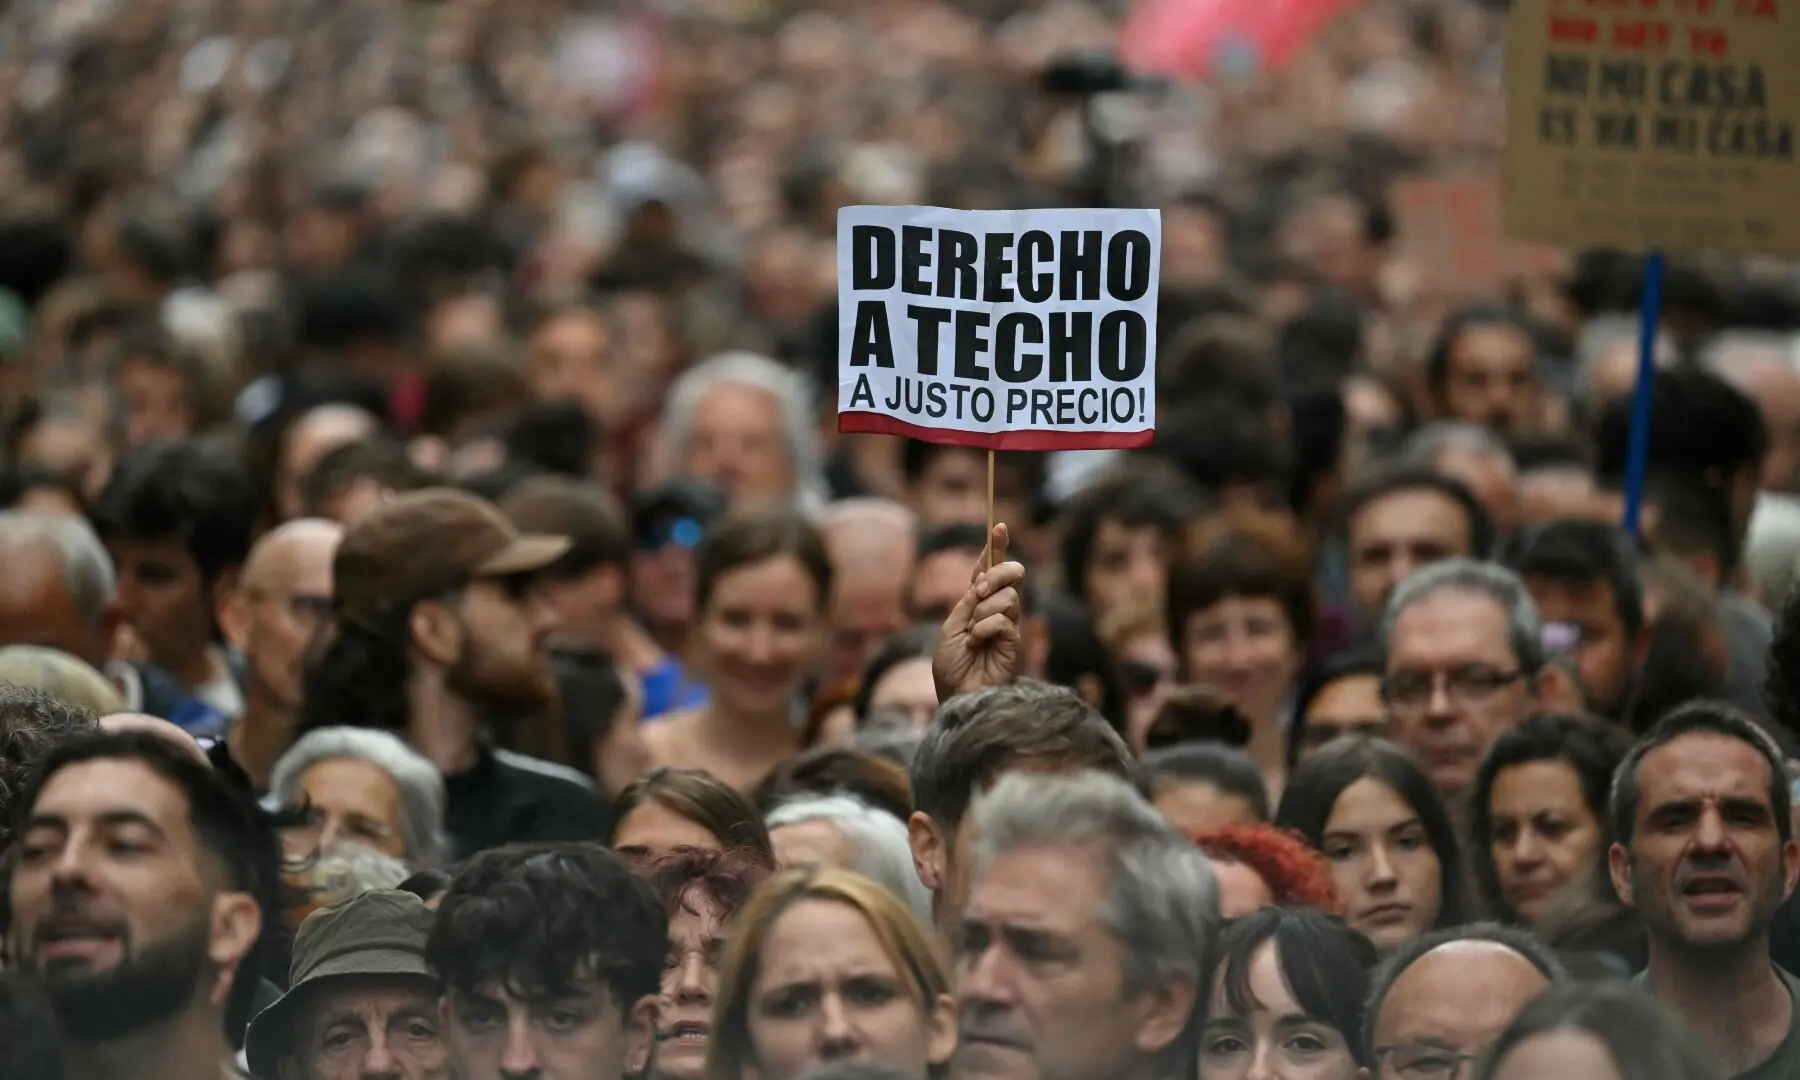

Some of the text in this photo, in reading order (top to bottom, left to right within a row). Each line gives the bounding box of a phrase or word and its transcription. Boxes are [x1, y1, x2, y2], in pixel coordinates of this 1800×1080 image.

[1659, 61, 1766, 107] CASA
[1707, 119, 1793, 161] CASA
[852, 224, 1151, 304] DERECHO
[849, 300, 1147, 384] A TECHO
[849, 373, 1146, 425] A JUSTO PRECIO!
